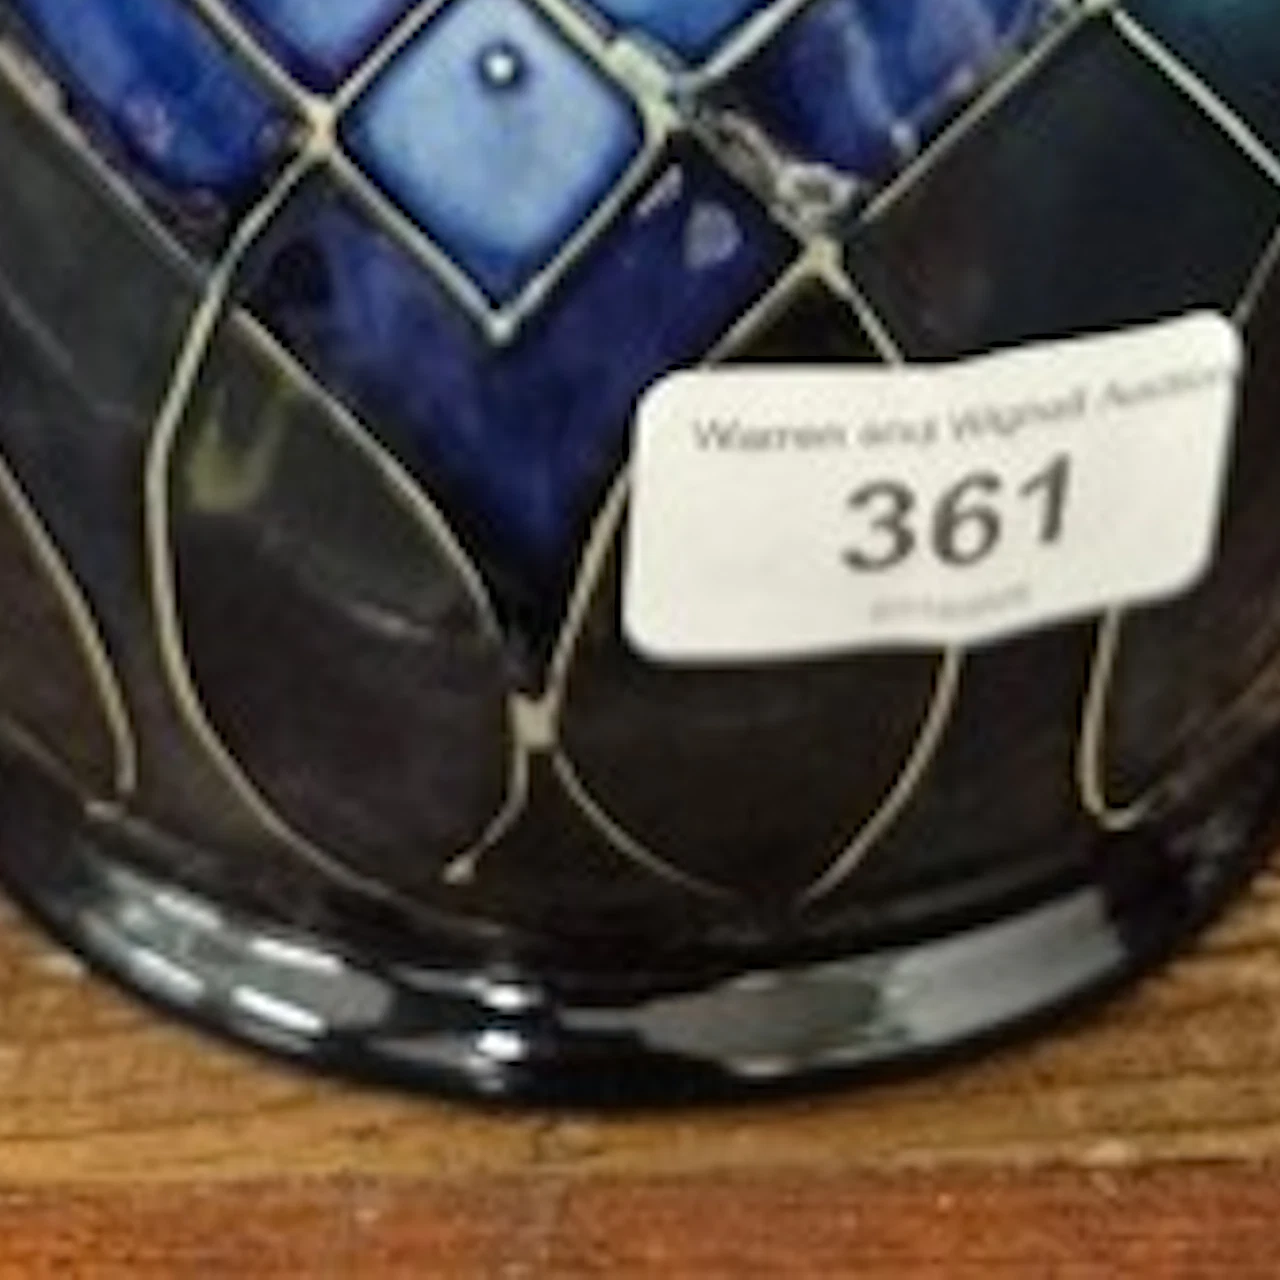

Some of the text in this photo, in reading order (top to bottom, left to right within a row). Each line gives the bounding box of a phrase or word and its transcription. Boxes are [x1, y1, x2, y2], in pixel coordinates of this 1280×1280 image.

[692, 416, 848, 452] Warren
[858, 412, 938, 448] and
[840, 451, 1073, 572] 361
